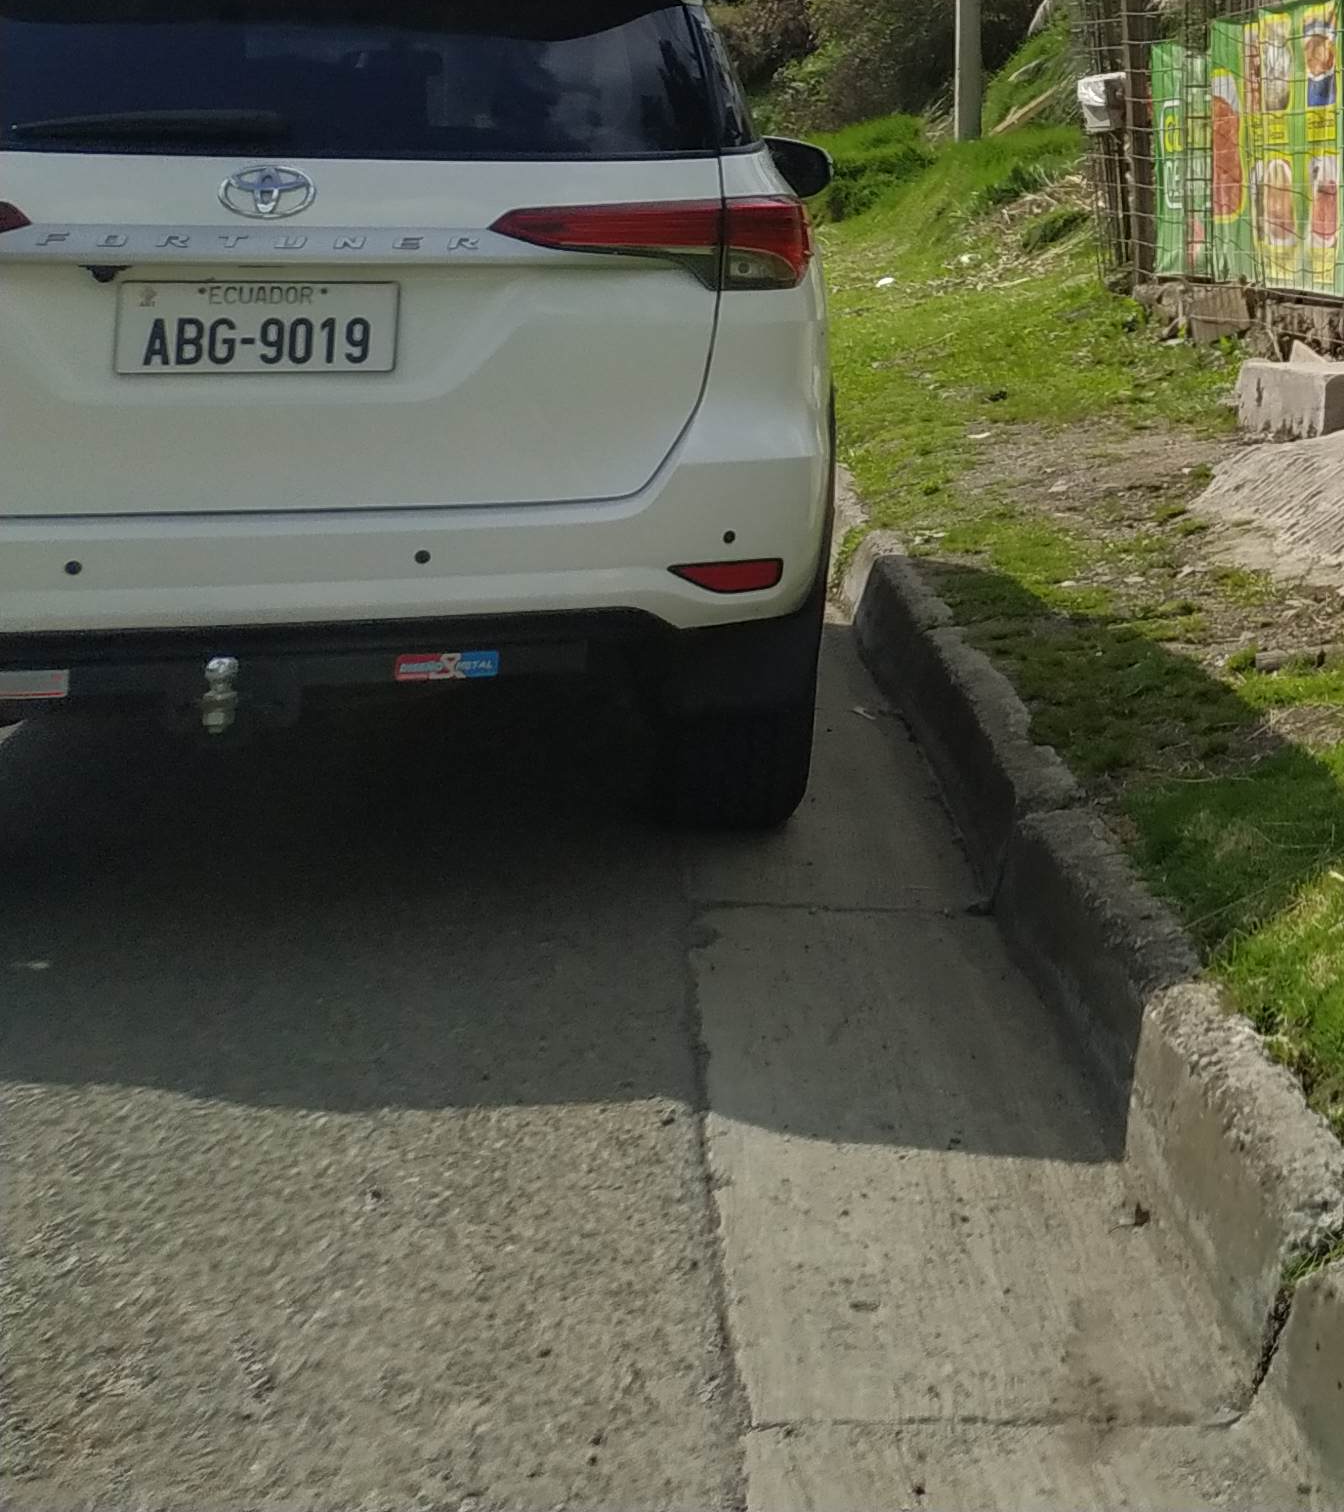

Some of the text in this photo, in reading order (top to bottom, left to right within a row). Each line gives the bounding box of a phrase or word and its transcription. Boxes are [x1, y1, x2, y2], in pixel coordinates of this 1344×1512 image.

[35, 231, 481, 251] FORTUNER
[207, 285, 314, 306] ECUADOR
[143, 316, 372, 367] ABG-9019
